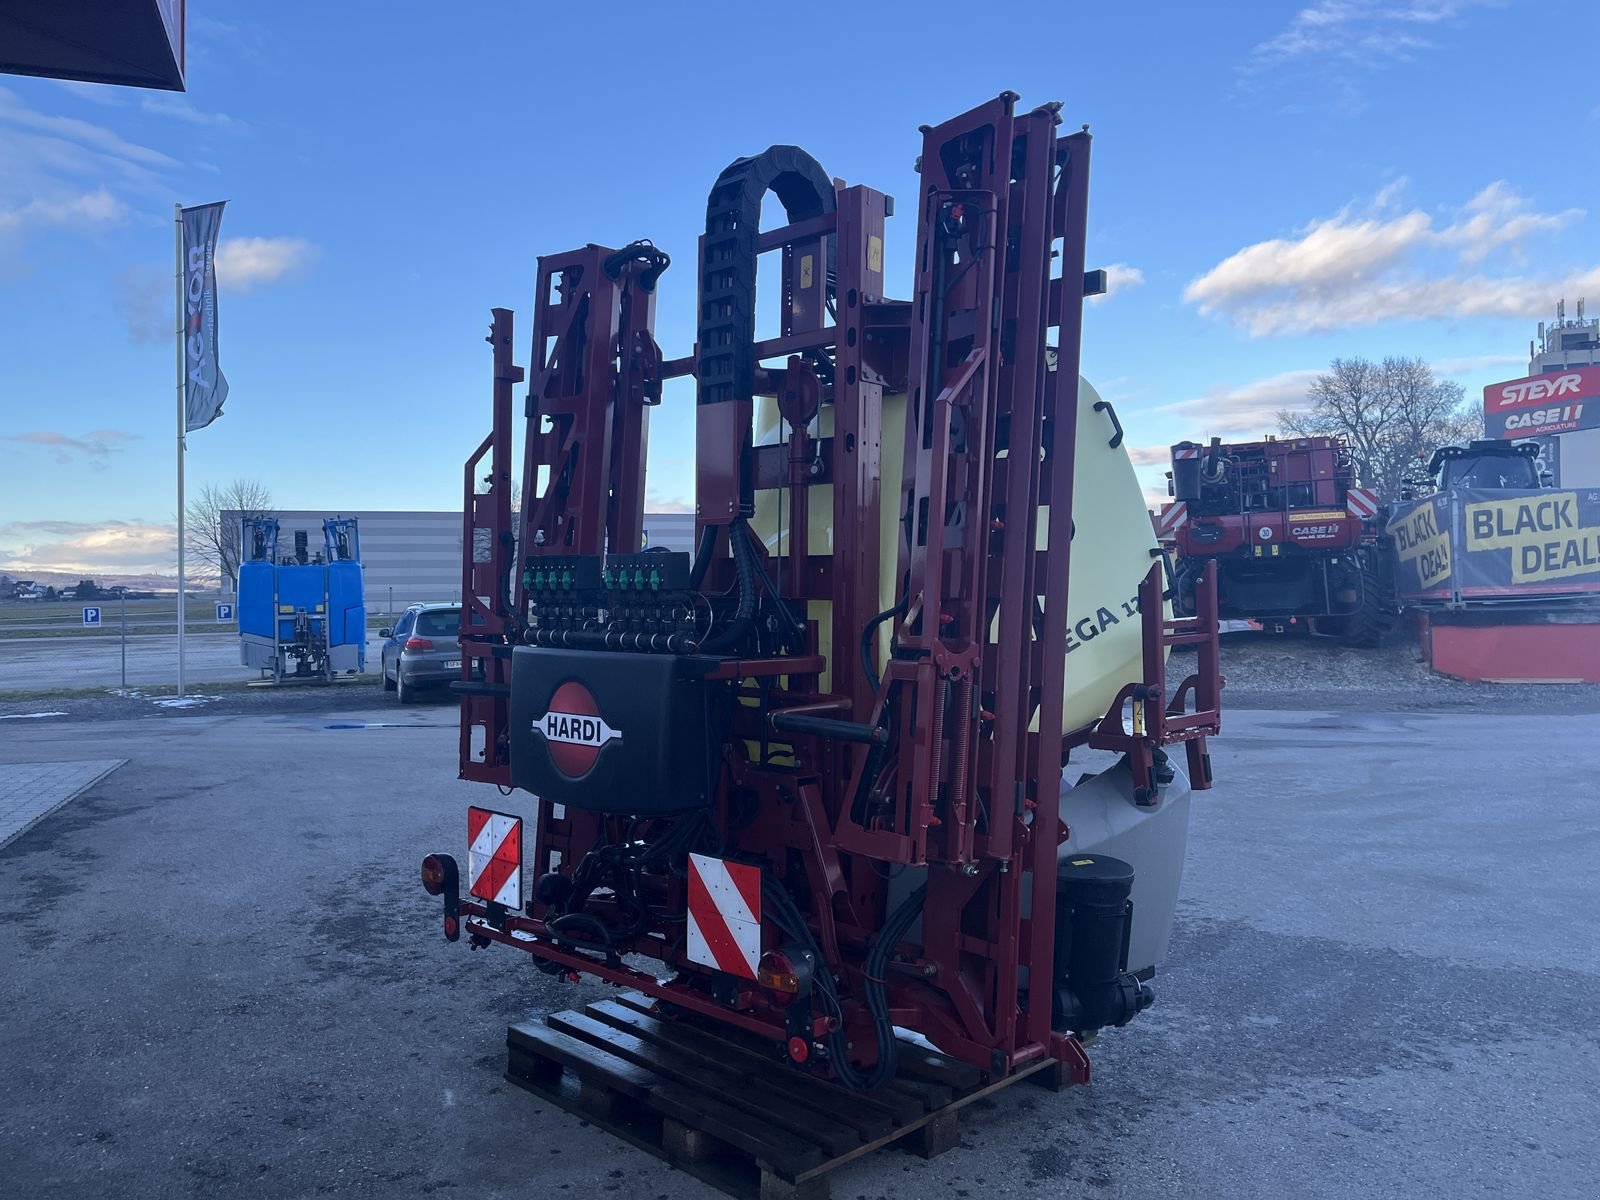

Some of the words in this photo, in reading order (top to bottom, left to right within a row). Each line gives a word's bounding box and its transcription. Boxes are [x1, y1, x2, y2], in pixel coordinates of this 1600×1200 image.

[1500, 374, 1582, 405] STEYR
[1505, 408, 1560, 430] CASE
[1292, 526, 1327, 535] CASE
[1395, 509, 1436, 551] BLACK
[1473, 499, 1573, 539] BLACK
[1420, 543, 1449, 580] DEAL!
[1522, 535, 1600, 574] DEAL!
[87, 609, 97, 622] P
[220, 606, 229, 618] P
[547, 715, 601, 742] HARDI
